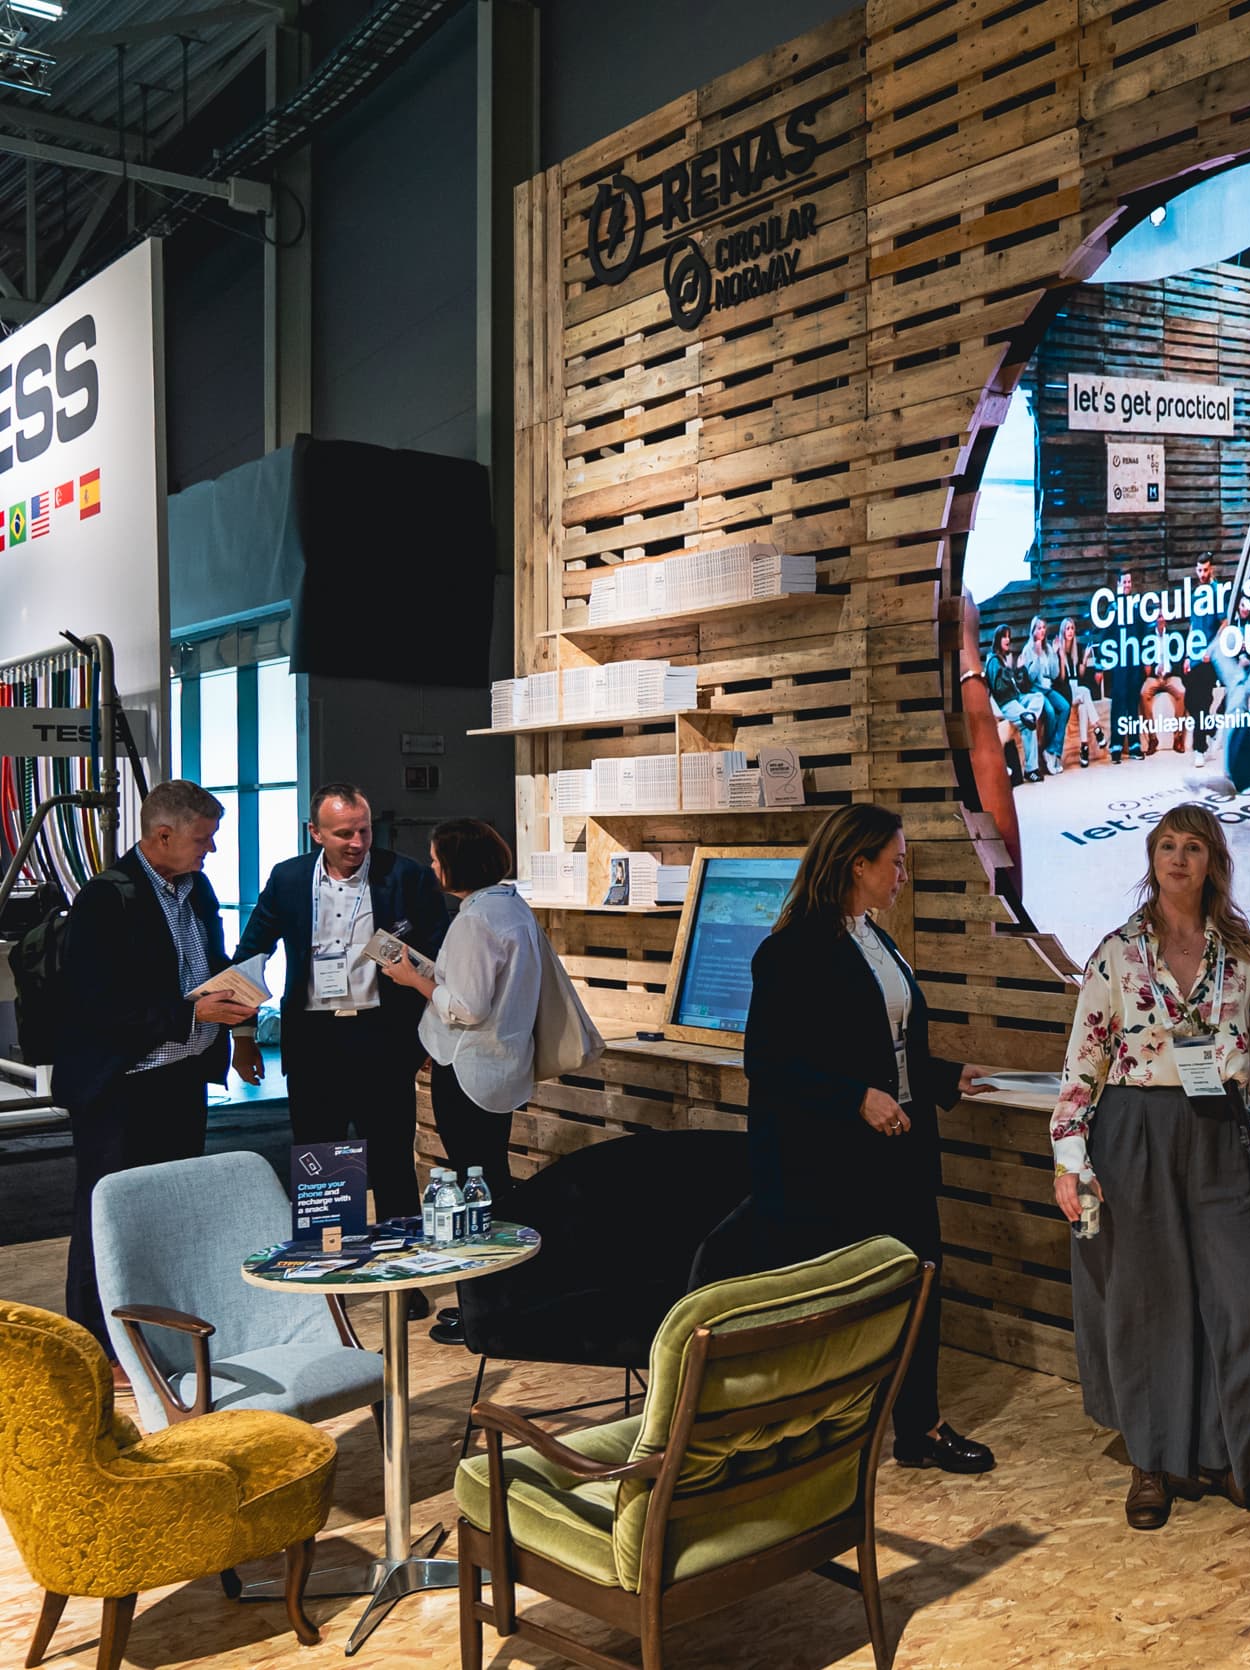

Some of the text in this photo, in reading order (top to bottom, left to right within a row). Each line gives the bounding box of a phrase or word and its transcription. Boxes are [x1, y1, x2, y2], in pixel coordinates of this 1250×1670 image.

[662, 111, 818, 231] RENAS
[715, 203, 817, 272] CIRCULAR
[715, 248, 801, 311] NORWAY
[1121, 391, 1151, 423] get
[1156, 394, 1230, 422] practical
[1090, 576, 1231, 629] Circular
[1100, 627, 1208, 671] shape
[1117, 713, 1195, 736] Sirkulære
[297, 1181, 346, 1191] Charge your
[298, 1188, 340, 1200] phone and
[298, 1195, 351, 1207] recharge with
[305, 1205, 329, 1214] snack
